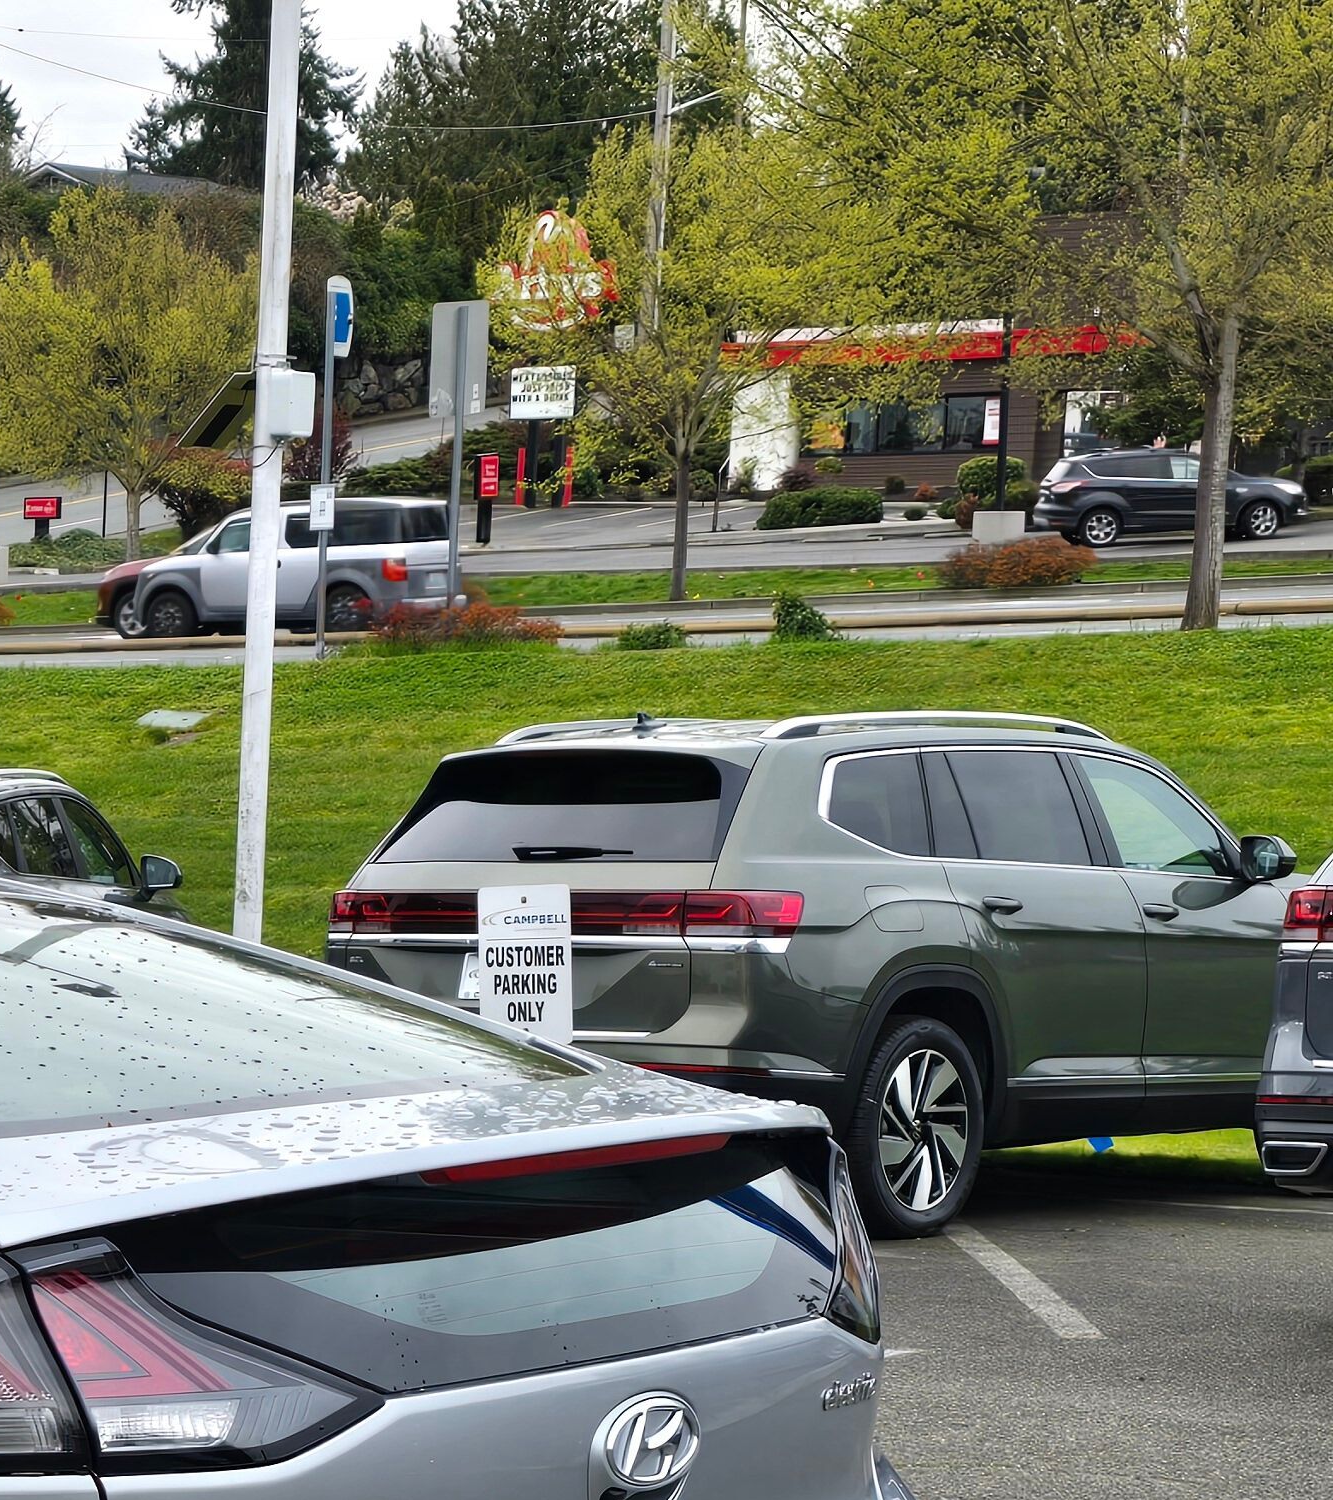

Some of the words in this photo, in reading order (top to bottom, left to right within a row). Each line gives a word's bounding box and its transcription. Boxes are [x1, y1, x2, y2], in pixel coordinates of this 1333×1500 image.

[503, 913, 568, 925] CAMPBELL
[485, 945, 566, 968] CUSTOMER
[493, 972, 558, 996] PARKING
[506, 1000, 545, 1023] ONLY
